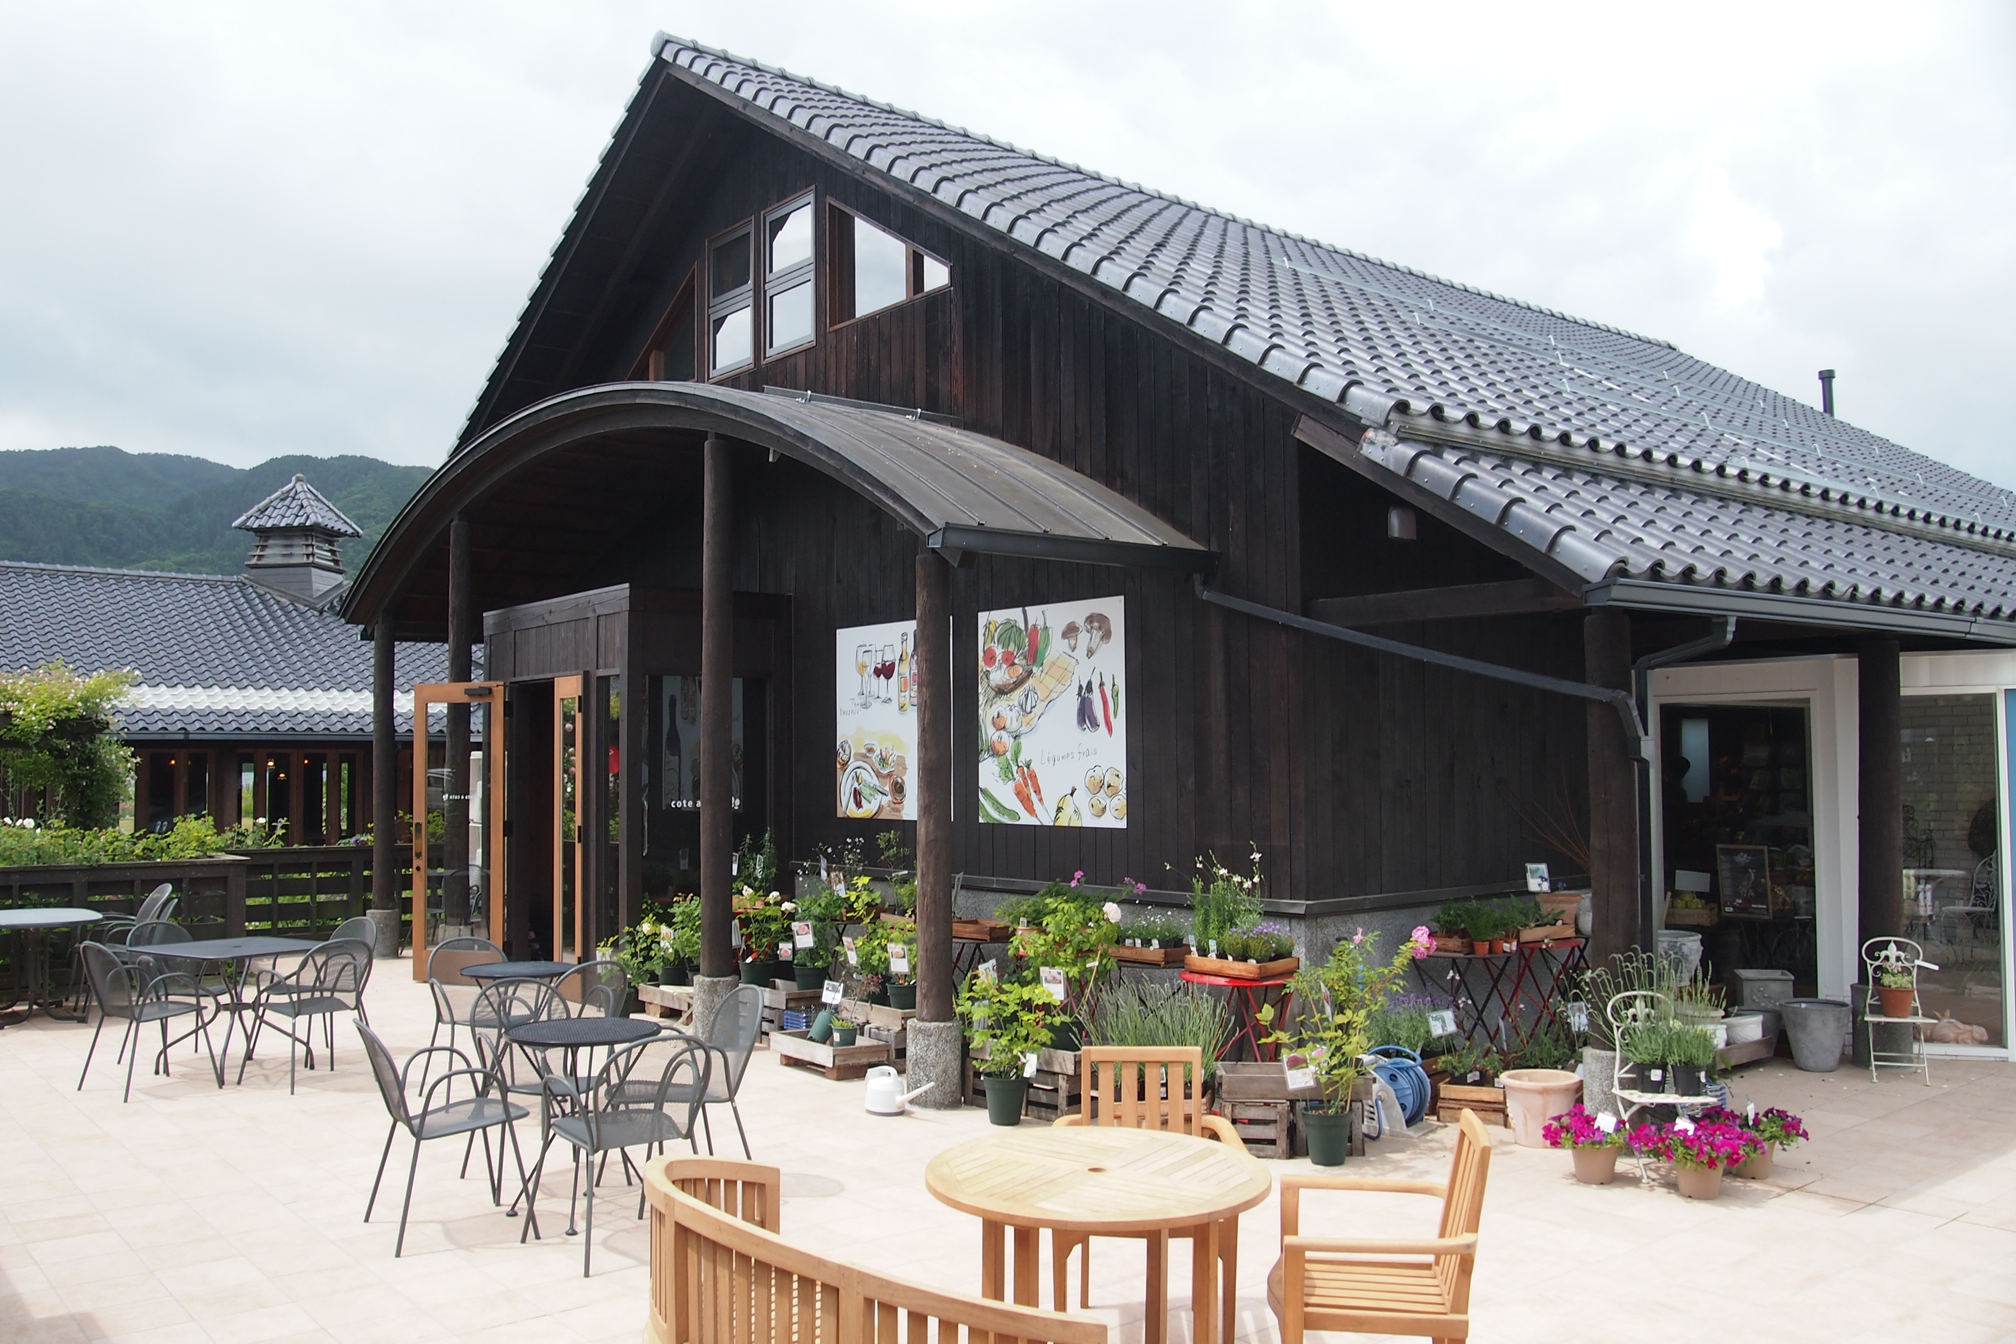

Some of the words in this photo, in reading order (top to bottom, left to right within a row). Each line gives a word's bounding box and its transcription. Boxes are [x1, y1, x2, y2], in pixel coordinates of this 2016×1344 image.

[1040, 750, 1075, 767] Légumes
[1077, 743, 1098, 761] frais
[670, 799, 693, 808] cote
